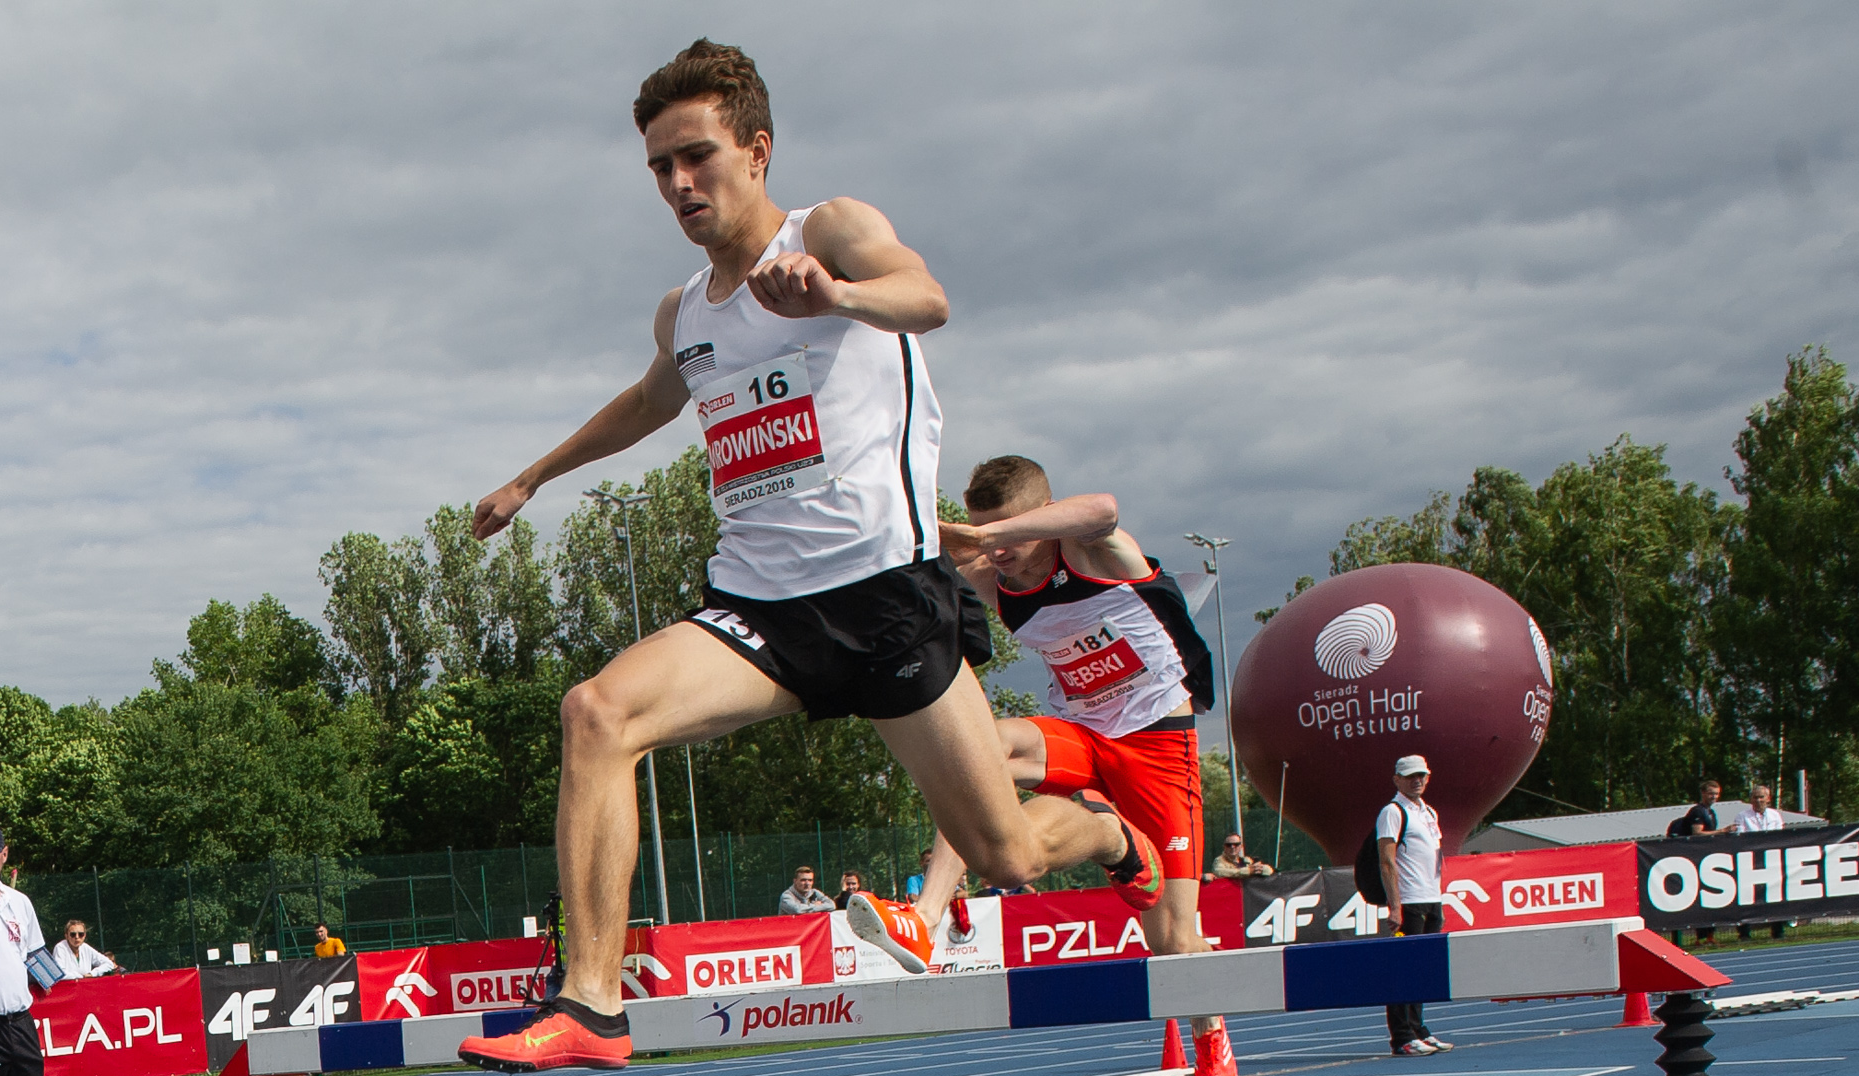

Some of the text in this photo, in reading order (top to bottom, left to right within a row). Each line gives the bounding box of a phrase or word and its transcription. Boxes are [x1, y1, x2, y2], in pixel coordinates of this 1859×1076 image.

[748, 370, 789, 405] 16
[724, 486, 765, 508] SIERADZ
[765, 477, 795, 495] 2018
[1073, 627, 1115, 653] 181
[896, 662, 922, 678] 4F
[1060, 652, 1125, 689] DĘBSKI
[1298, 685, 1423, 729] Open Hair
[1314, 684, 1359, 701] Sieradz
[1509, 878, 1597, 909] ORLEN
[1648, 842, 1859, 912] OSHEE
[1246, 893, 1321, 943] 4F
[945, 946, 978, 956] TOYOTA
[1022, 911, 1221, 963] PZLAL
[693, 953, 793, 988] ORLEN
[289, 981, 355, 1026] 4F
[457, 974, 547, 1004] ORLEN
[33, 1006, 183, 1057] LA.PL
[208, 988, 276, 1041] 4F
[741, 992, 855, 1038] polanik
